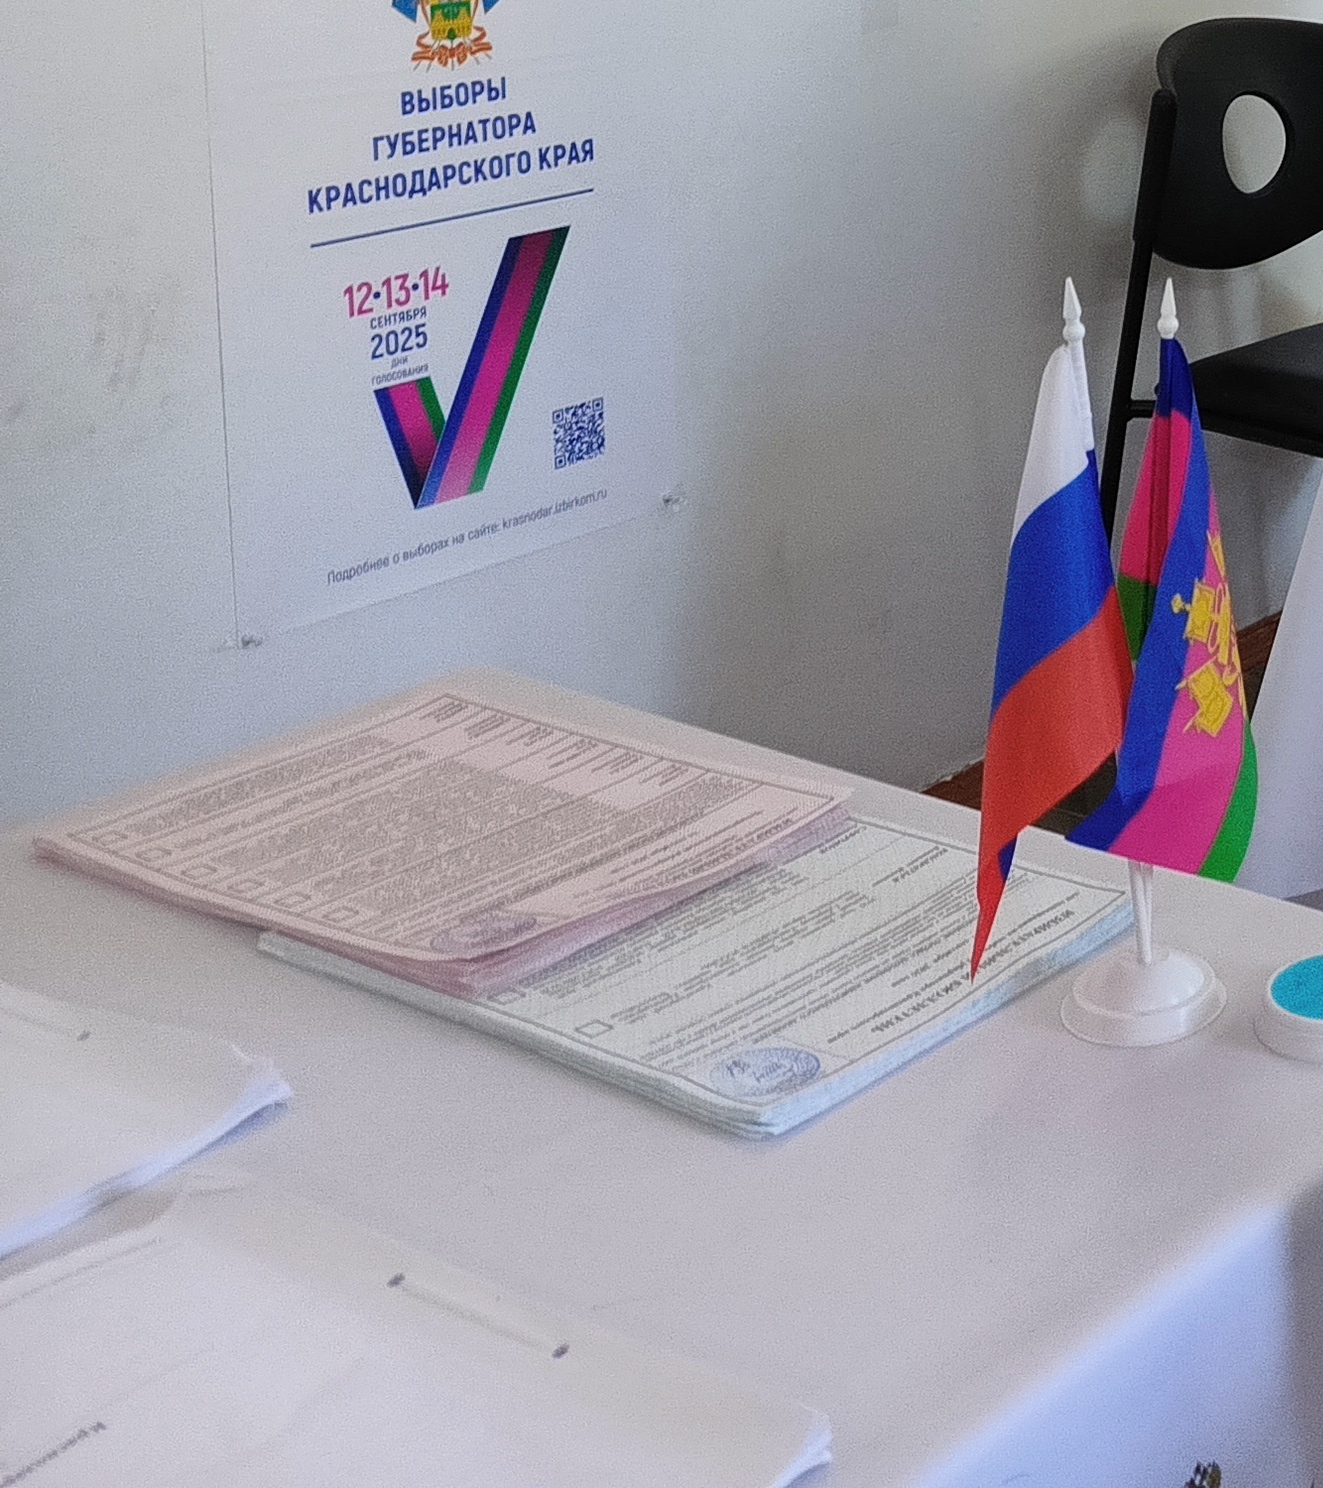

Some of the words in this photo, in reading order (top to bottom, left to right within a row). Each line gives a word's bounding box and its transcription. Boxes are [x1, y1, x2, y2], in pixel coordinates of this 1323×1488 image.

[400, 76, 507, 115] ВЫБОРЫ
[372, 111, 536, 161] ГУБЕРНАТОРА
[307, 149, 532, 215] КРАСНОДАРСКОГО
[538, 138, 595, 172] КРАЯ
[370, 306, 427, 330] СЕНТЯБРЯ
[370, 323, 428, 360] 2025
[371, 364, 428, 386] ГОЛОСОВАНИЯ
[390, 356, 408, 369] ДНИ
[326, 557, 390, 587] Подробнее
[392, 552, 400, 563] о
[402, 538, 449, 563] выборах
[452, 533, 465, 546] на
[467, 522, 500, 541] сайте:
